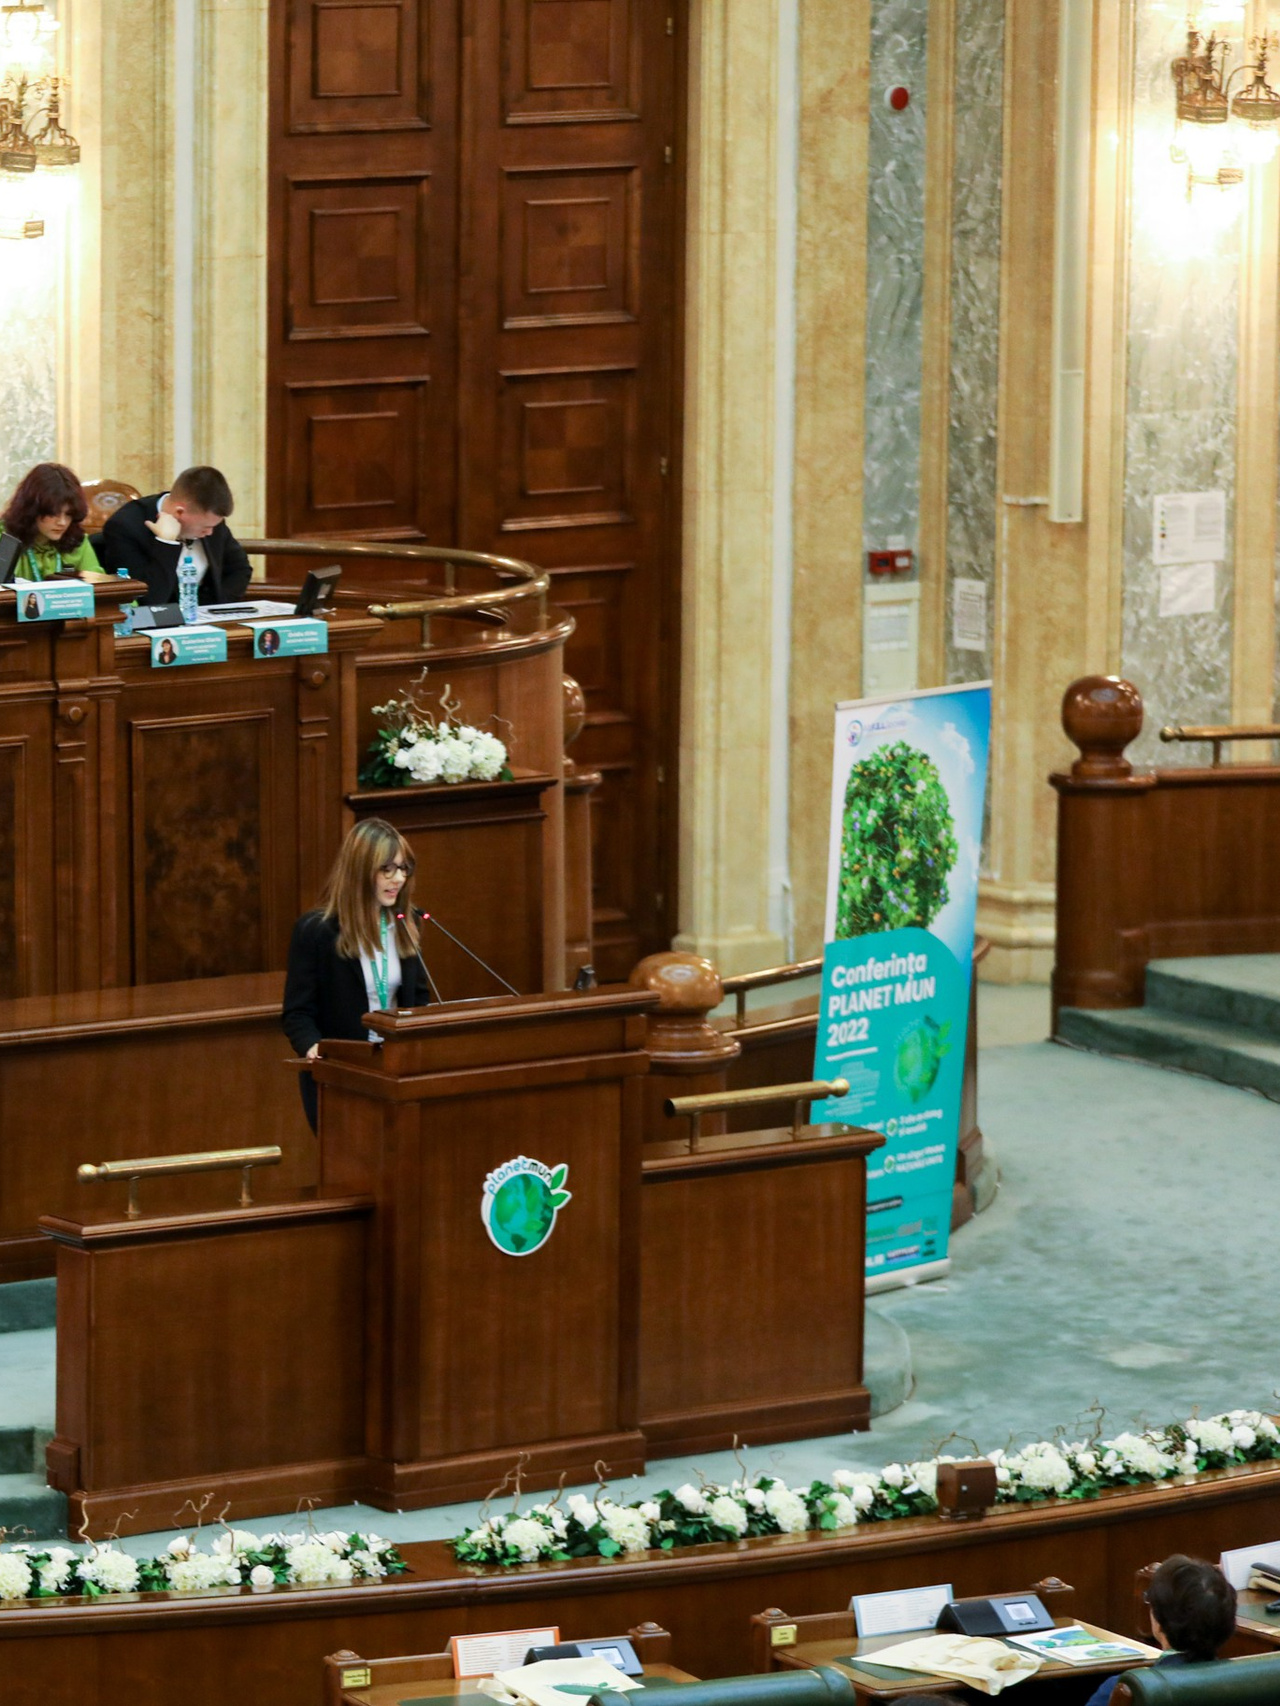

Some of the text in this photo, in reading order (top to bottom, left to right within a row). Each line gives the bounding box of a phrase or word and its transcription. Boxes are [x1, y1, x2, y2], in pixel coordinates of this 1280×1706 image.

[831, 952, 928, 988] Conferința
[828, 976, 936, 1018] PLANET MUN
[826, 1016, 869, 1047] 2022
